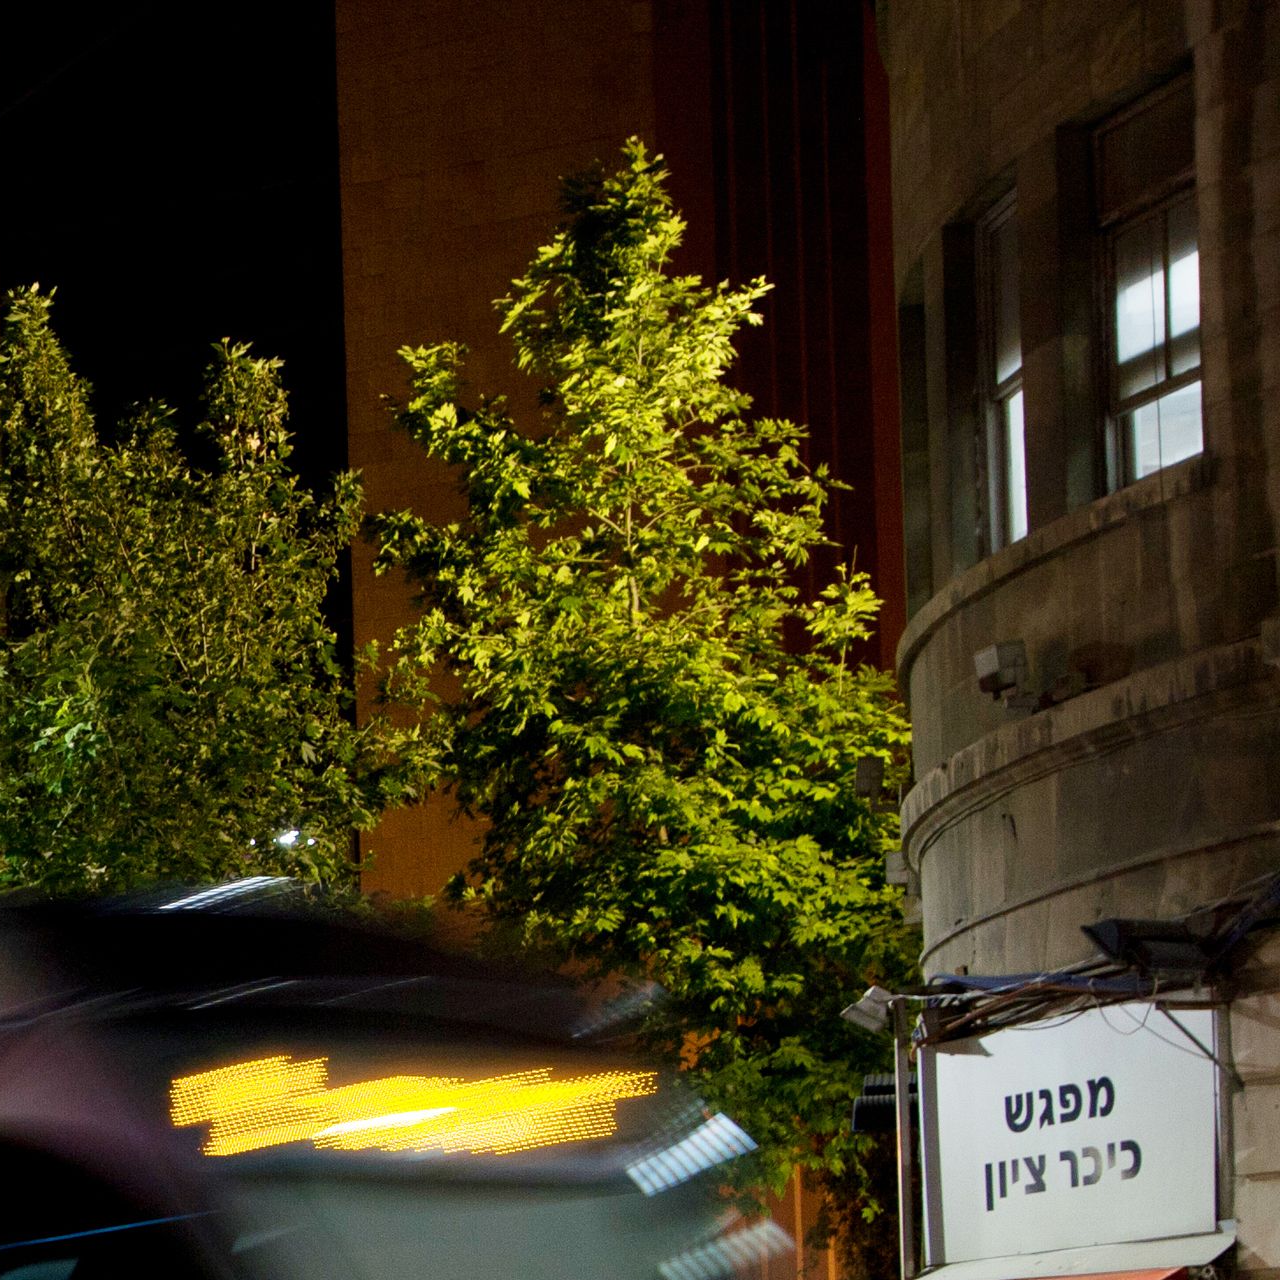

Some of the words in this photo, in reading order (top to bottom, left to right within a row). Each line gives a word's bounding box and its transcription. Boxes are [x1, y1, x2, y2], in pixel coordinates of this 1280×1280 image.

[1004, 1076, 1115, 1132] מפגש
[985, 1154, 1047, 1211] ציון
[1059, 1139, 1142, 1188] כיכר
